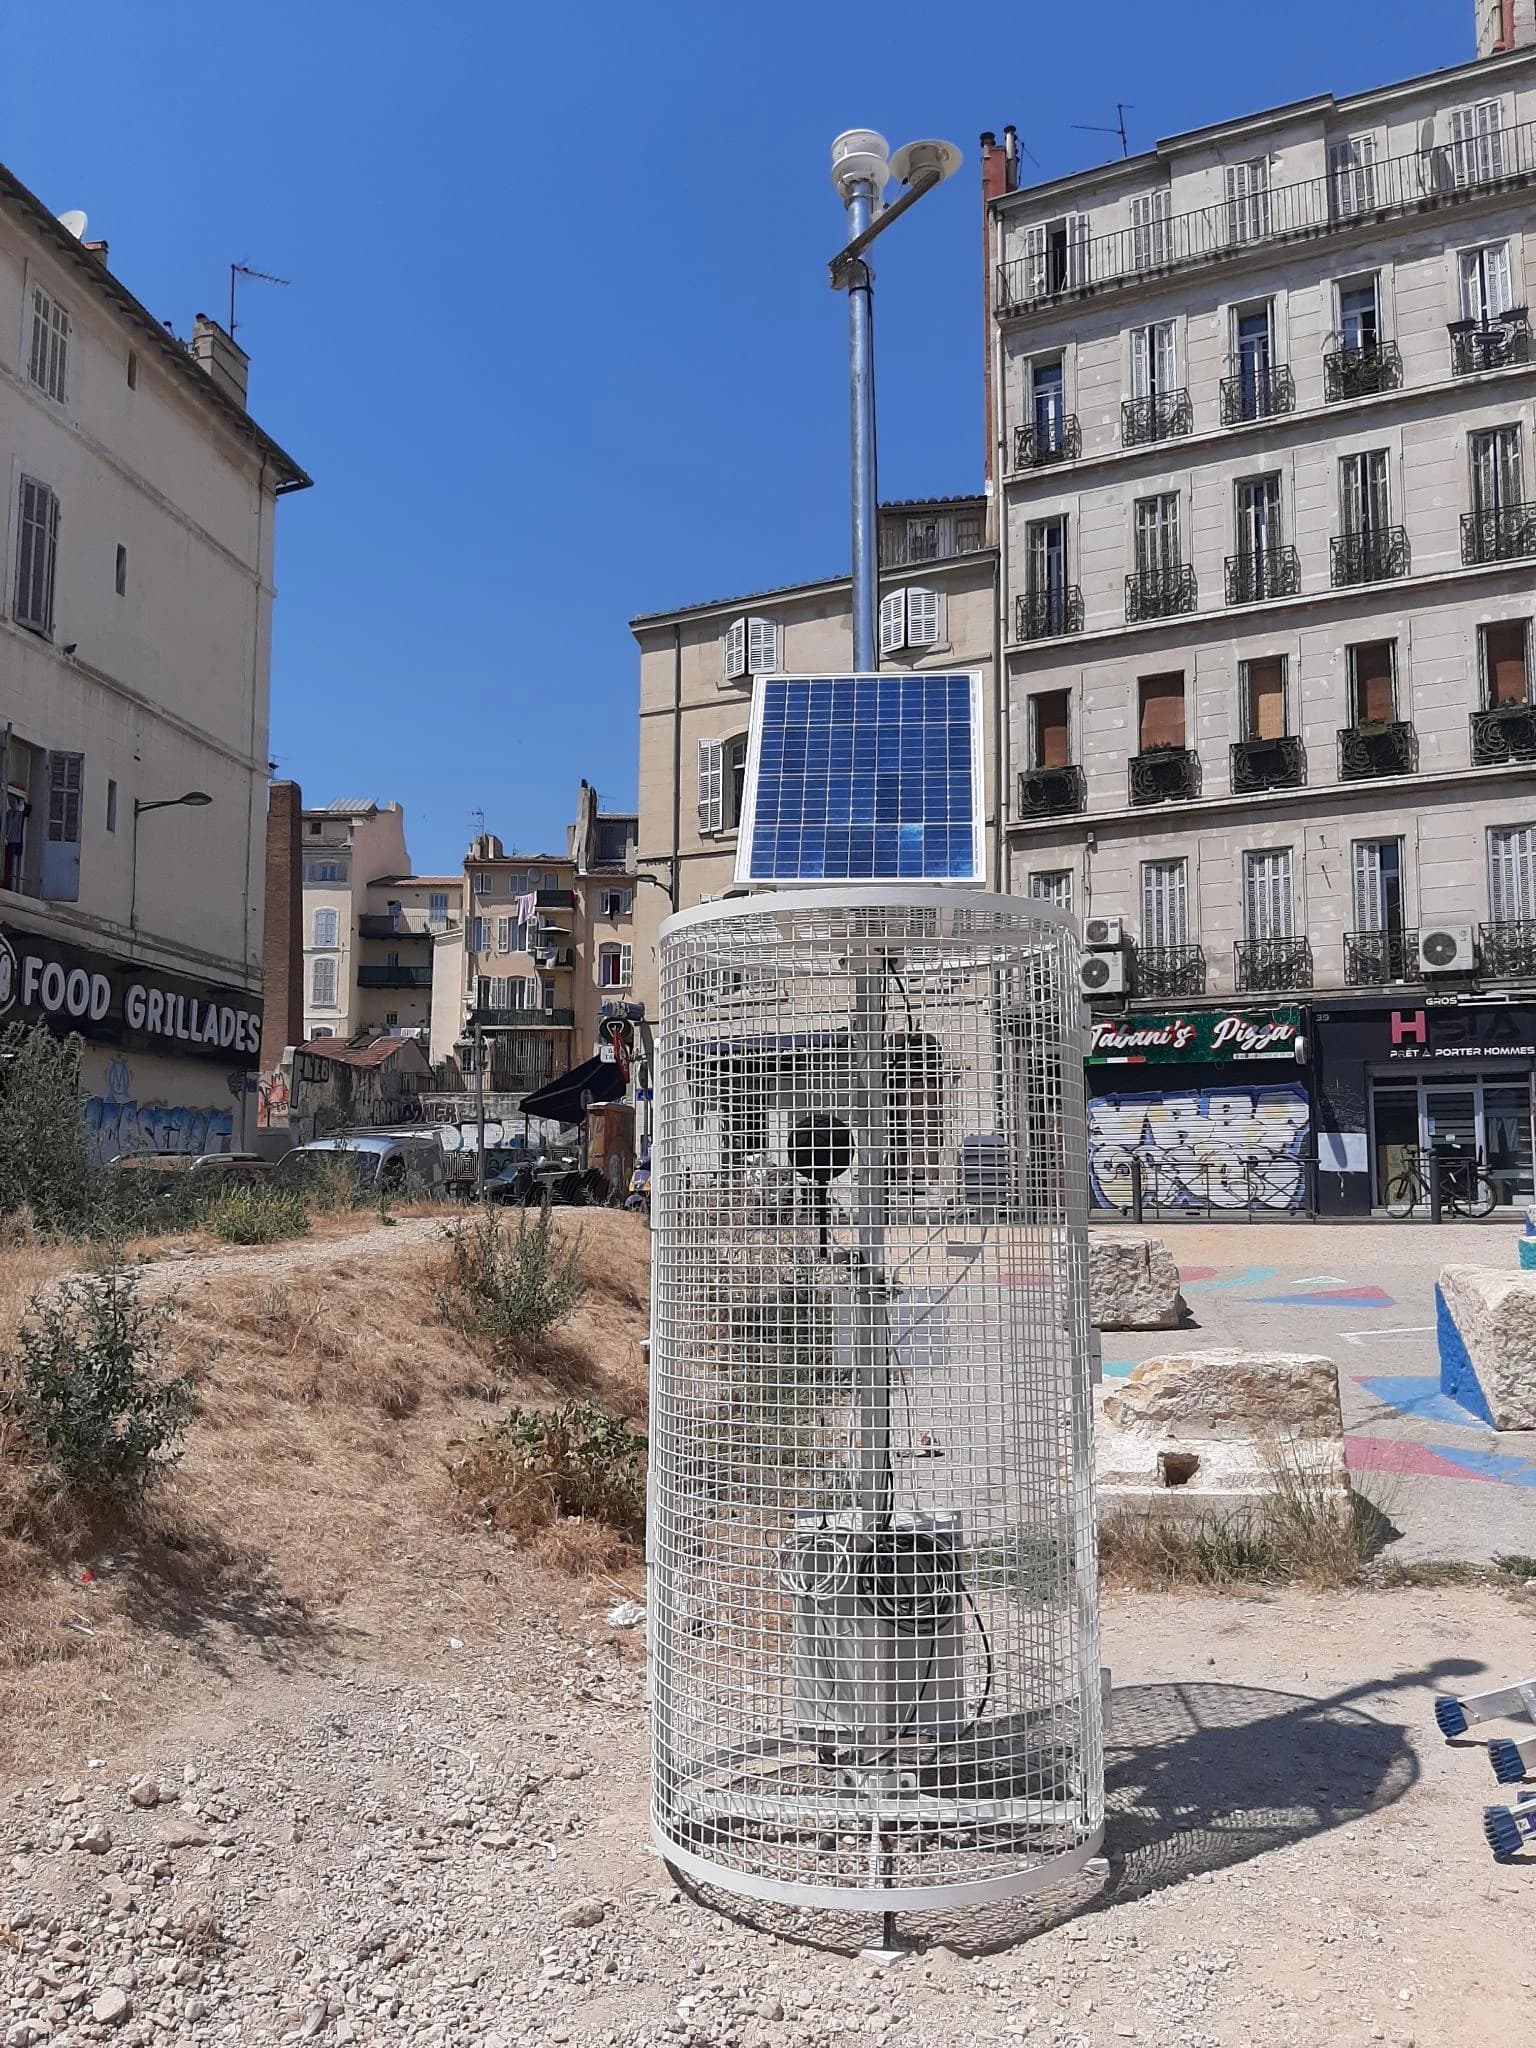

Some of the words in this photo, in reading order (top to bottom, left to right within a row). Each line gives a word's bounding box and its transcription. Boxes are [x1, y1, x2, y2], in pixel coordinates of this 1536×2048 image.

[22, 956, 112, 1020] FOOD
[125, 984, 262, 1053] GRILLADES
[1425, 997, 1458, 1006] GROS
[1315, 1013, 1330, 1022] 39
[1210, 1016, 1295, 1050] Pizza
[1435, 1047, 1482, 1057] PORTER
[1484, 1046, 1535, 1056] HOMMES
